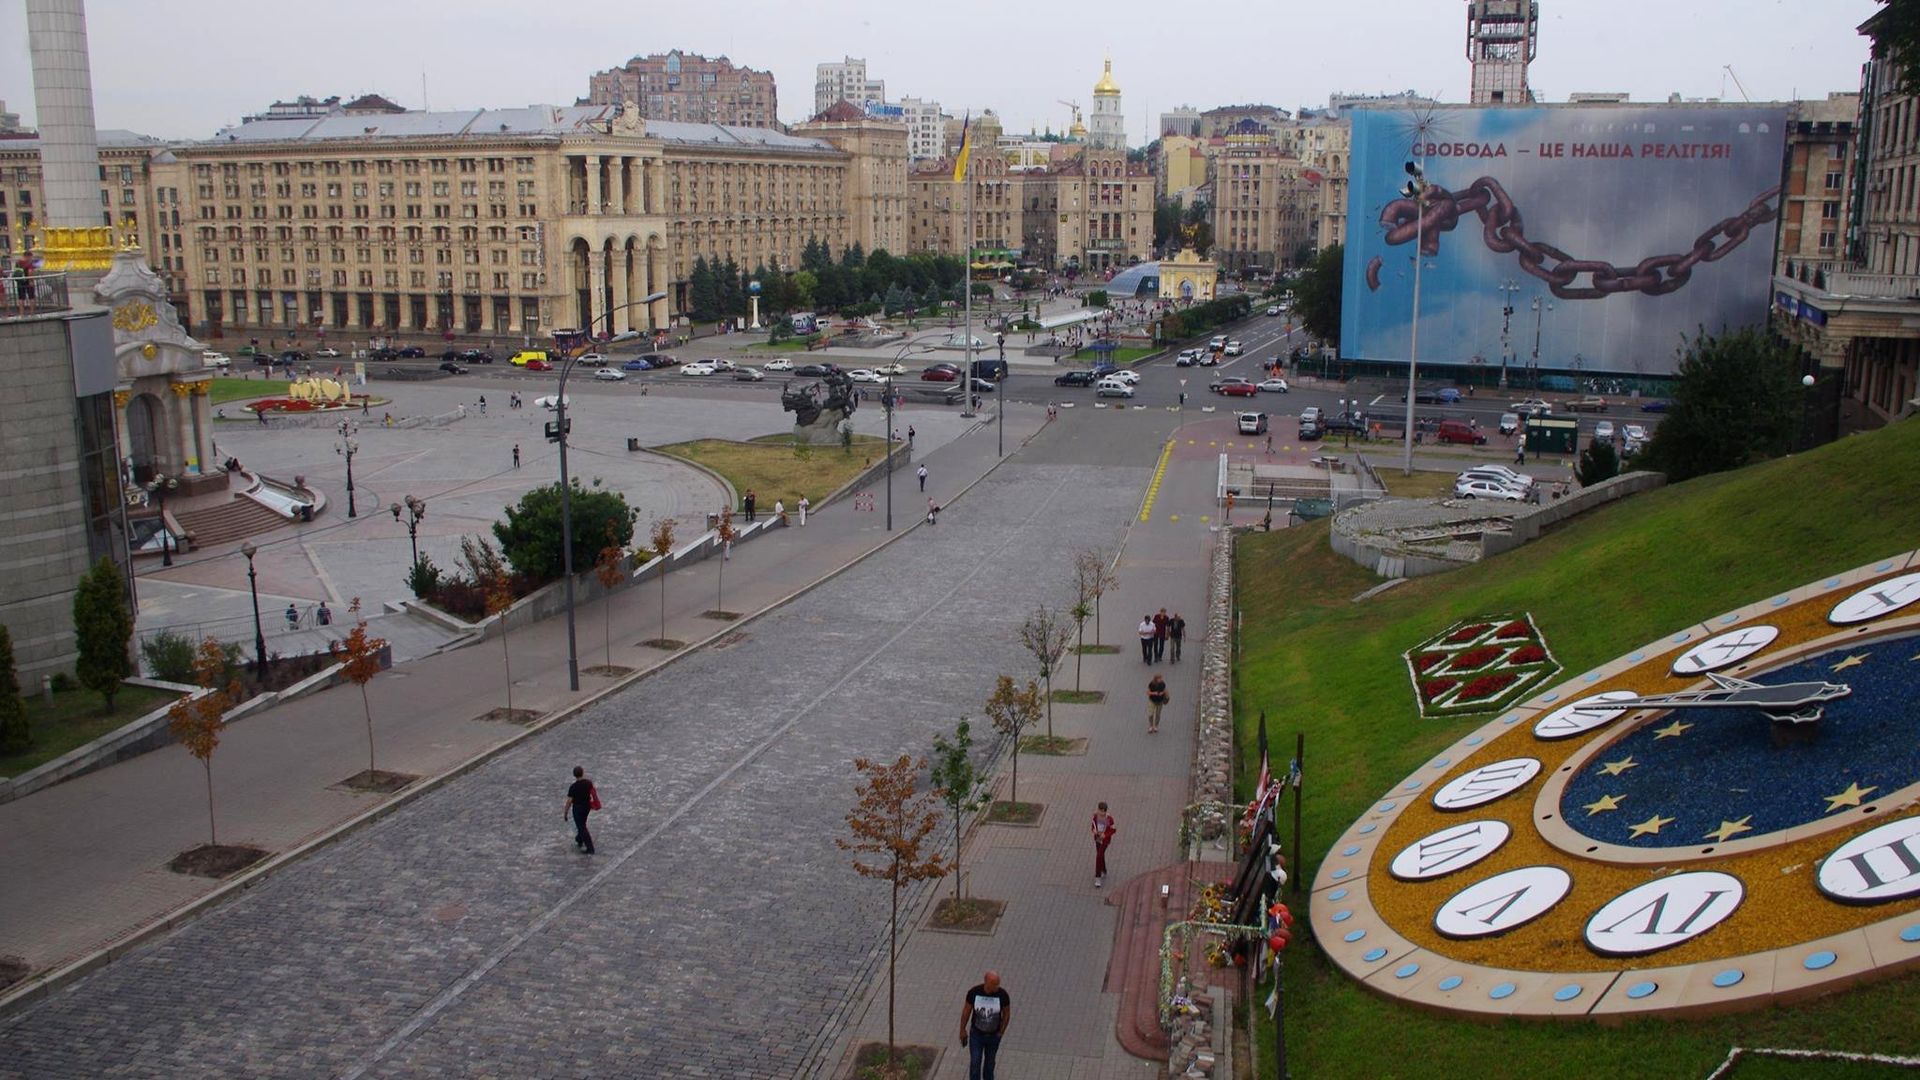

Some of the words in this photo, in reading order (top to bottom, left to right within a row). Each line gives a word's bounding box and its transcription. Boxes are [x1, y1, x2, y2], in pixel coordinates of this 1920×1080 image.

[1411, 143, 1507, 158] СВОБОДА
[1539, 143, 1564, 159] ЦЕ
[1572, 143, 1634, 158] НАША
[1641, 143, 1732, 159] РЕЛІГІЯ!
[1455, 885, 1532, 925] V
